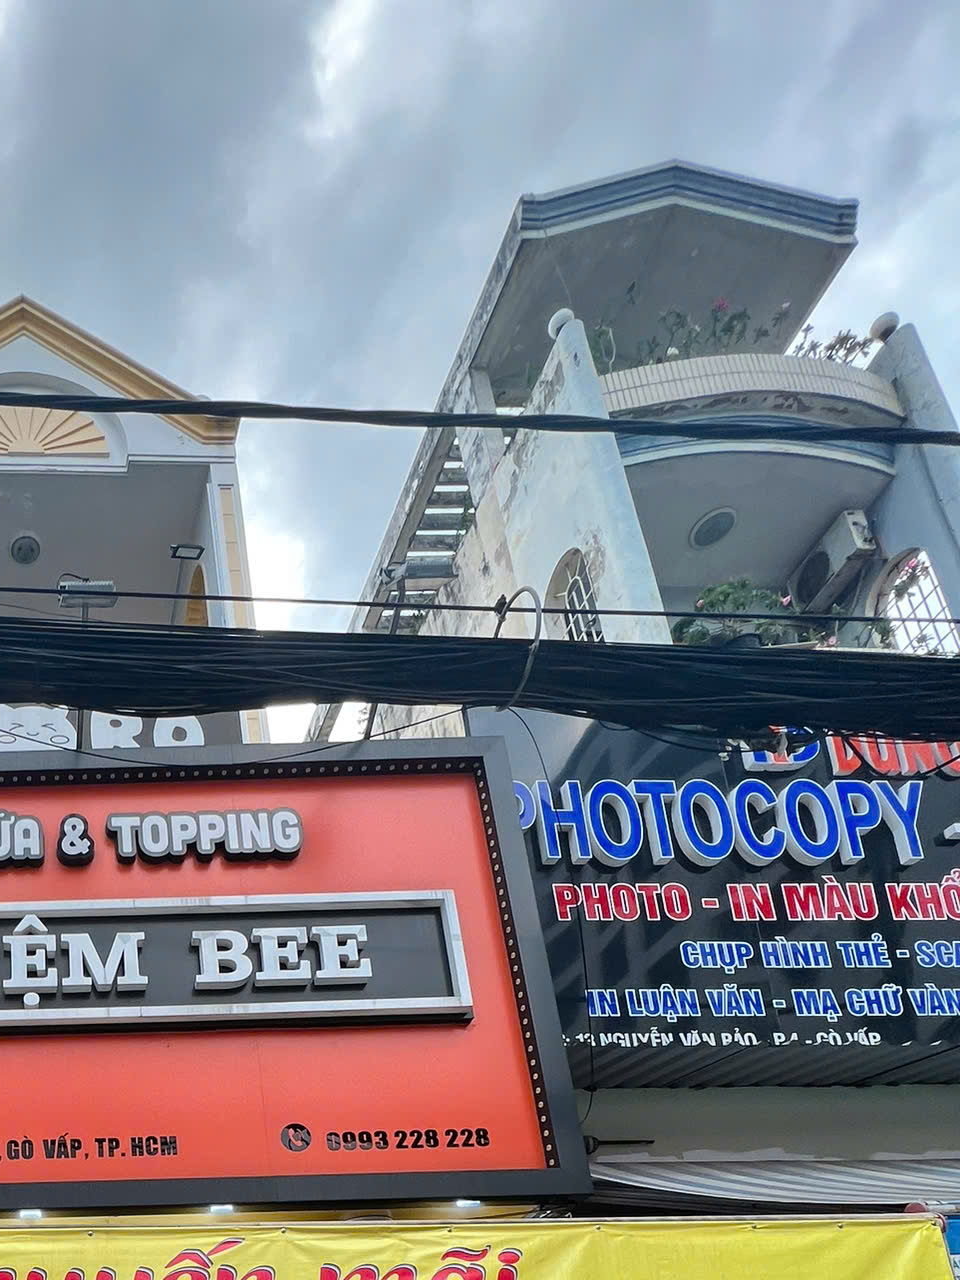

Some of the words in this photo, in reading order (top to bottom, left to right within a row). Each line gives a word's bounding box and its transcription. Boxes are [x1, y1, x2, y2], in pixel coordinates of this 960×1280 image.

[56, 813, 96, 867] &
[105, 806, 303, 864] TOPPING
[552, 883, 691, 921] PHOTO
[727, 883, 777, 921] IN
[781, 875, 879, 921] MÀU
[190, 924, 374, 992] BEE
[680, 941, 753, 974] CHỤP
[759, 934, 832, 969] HÌNH
[837, 932, 892, 969] THẺ
[585, 988, 621, 1018] IN
[624, 983, 701, 1023] LUẬN
[704, 983, 766, 1018] VĂN
[792, 988, 843, 1023] MẠ
[844, 983, 905, 1017] CHỮ
[6, 1134, 35, 1162] GÒ
[326, 1130, 390, 1151] 0993
[393, 1128, 440, 1150] 228
[444, 1127, 491, 1149] 228
